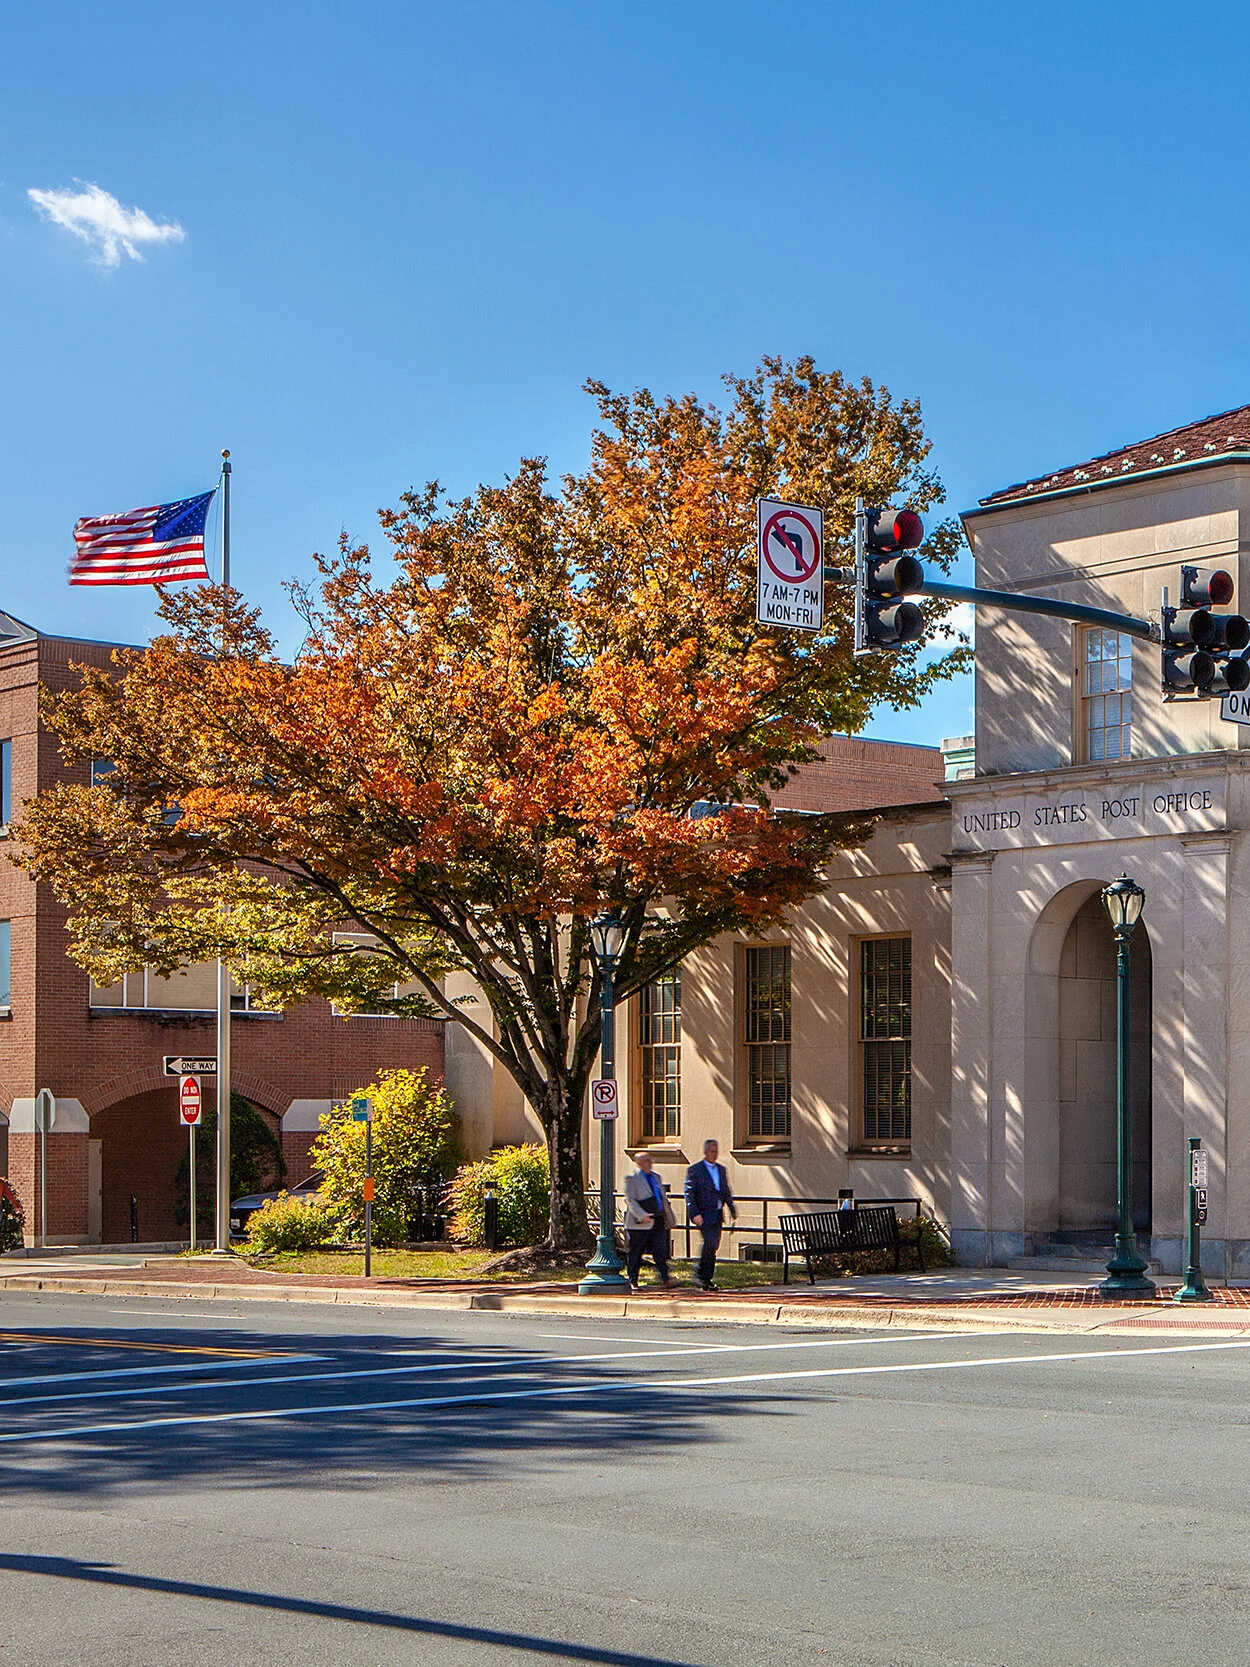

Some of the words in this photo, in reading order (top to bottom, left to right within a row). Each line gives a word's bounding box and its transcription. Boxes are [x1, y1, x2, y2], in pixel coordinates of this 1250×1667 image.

[763, 583, 769, 598] 7
[772, 585, 800, 603] AM-7
[803, 589, 818, 606] PM
[767, 603, 813, 624] MON-FRI
[963, 810, 1021, 833] UNITED
[1034, 803, 1087, 826] STATES
[1101, 798, 1140, 819] POST
[1153, 791, 1213, 813] OFFICE
[181, 1062, 197, 1070] ONE
[198, 1062, 214, 1070] WAY
[183, 1086, 190, 1094] DO
[185, 1107, 197, 1115] ENTER
